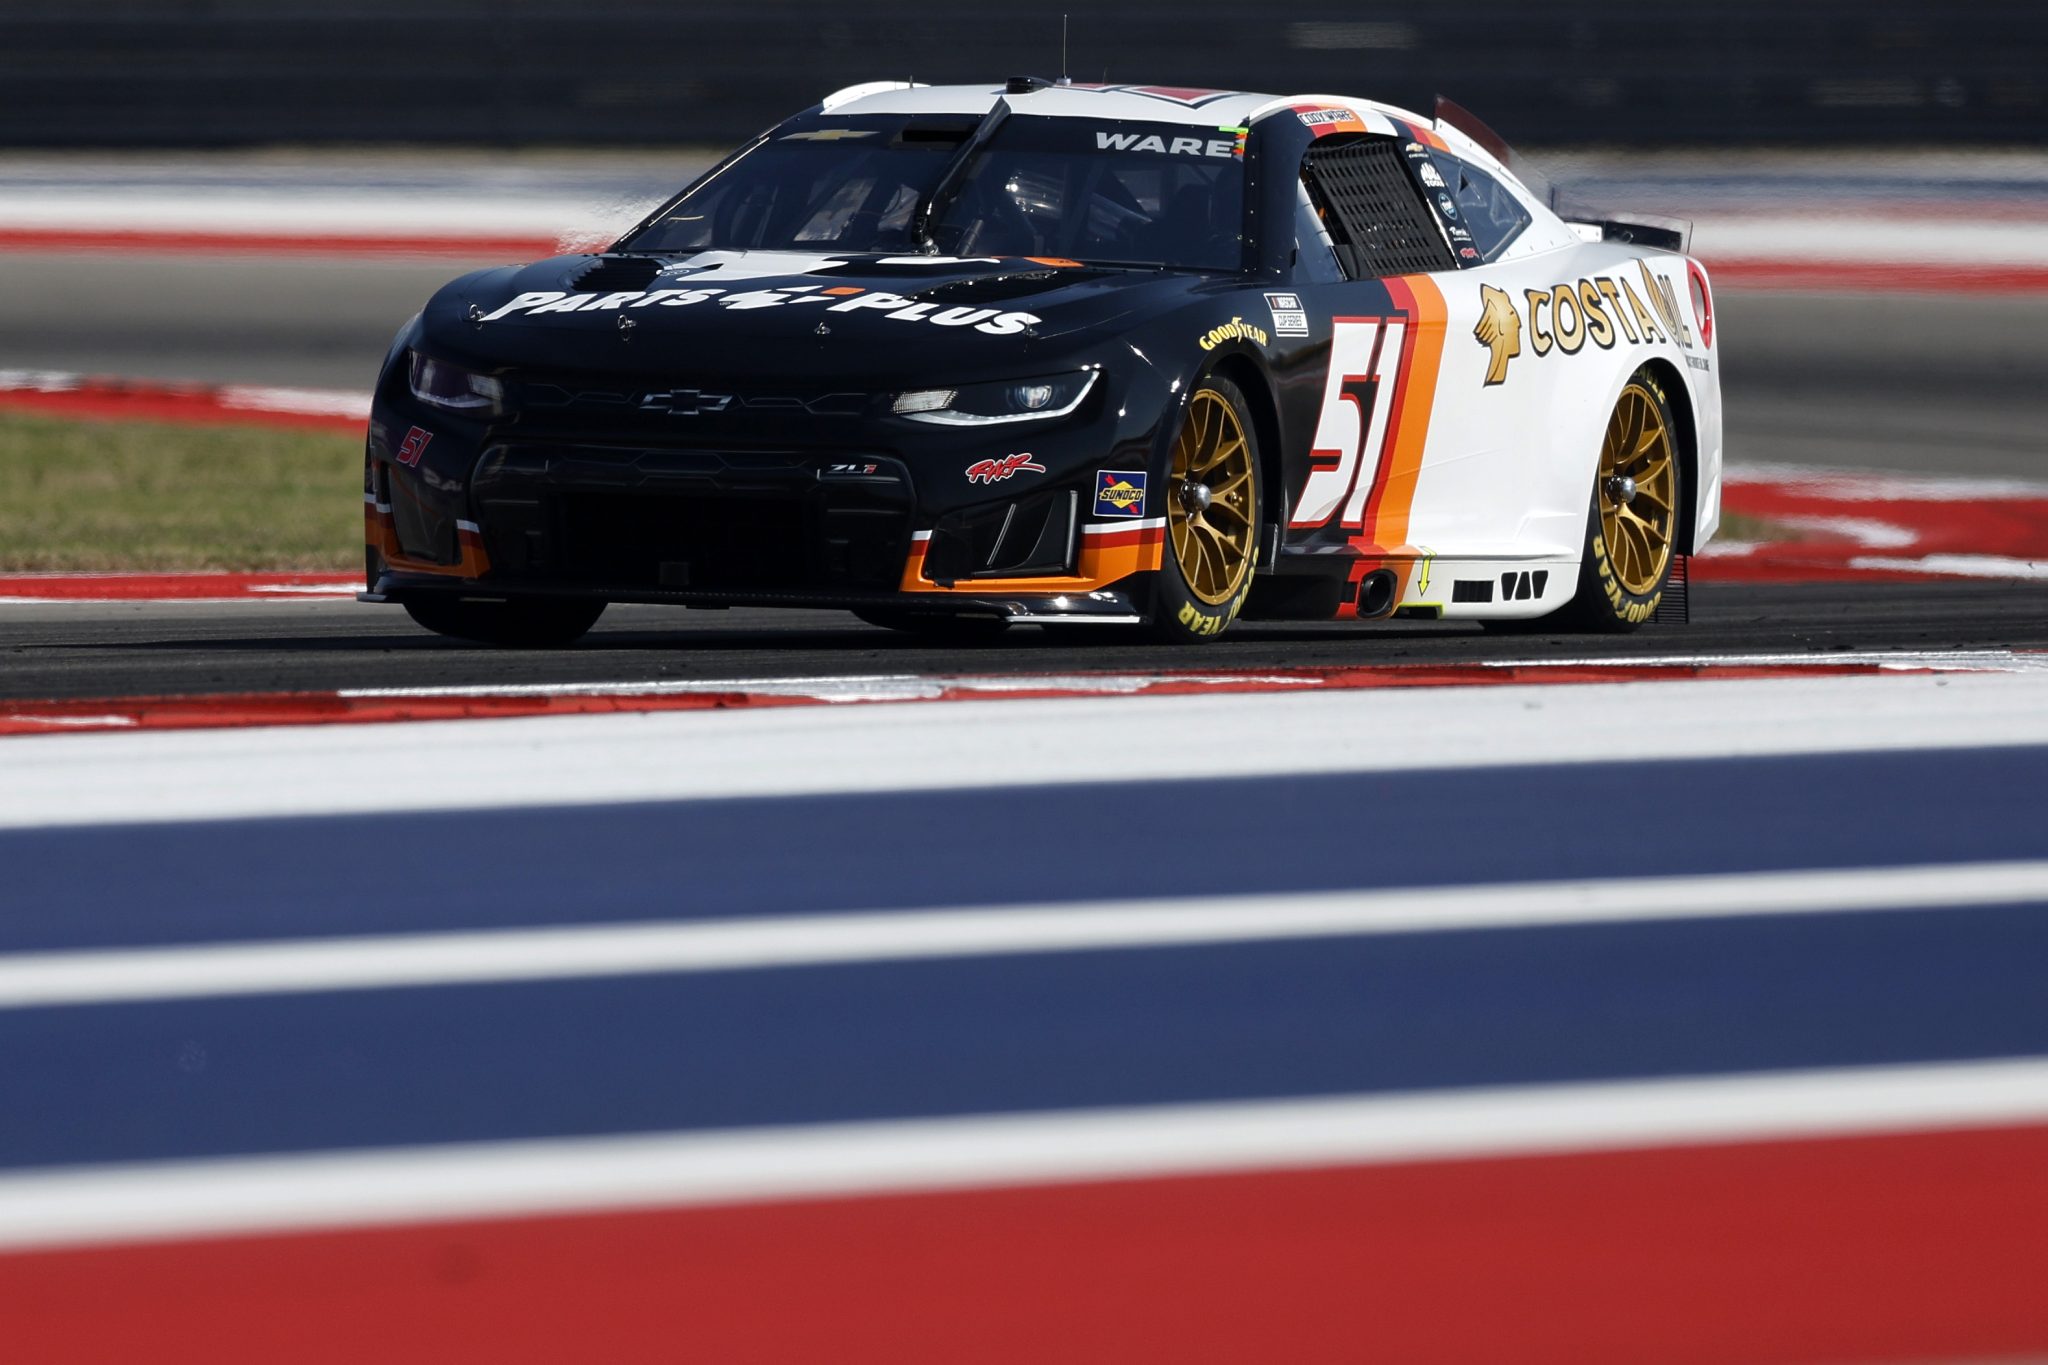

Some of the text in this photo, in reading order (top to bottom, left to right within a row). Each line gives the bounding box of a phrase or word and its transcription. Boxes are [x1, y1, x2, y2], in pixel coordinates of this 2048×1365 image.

[1298, 110, 1354, 125] CODY WARE
[1096, 132, 1234, 158] WARE
[477, 289, 1043, 334] PARTS PLUS
[1524, 277, 1667, 357] COSTA
[1289, 316, 1409, 529] 51
[396, 425, 434, 468] 51
[1101, 489, 1142, 501] SUNOCO
